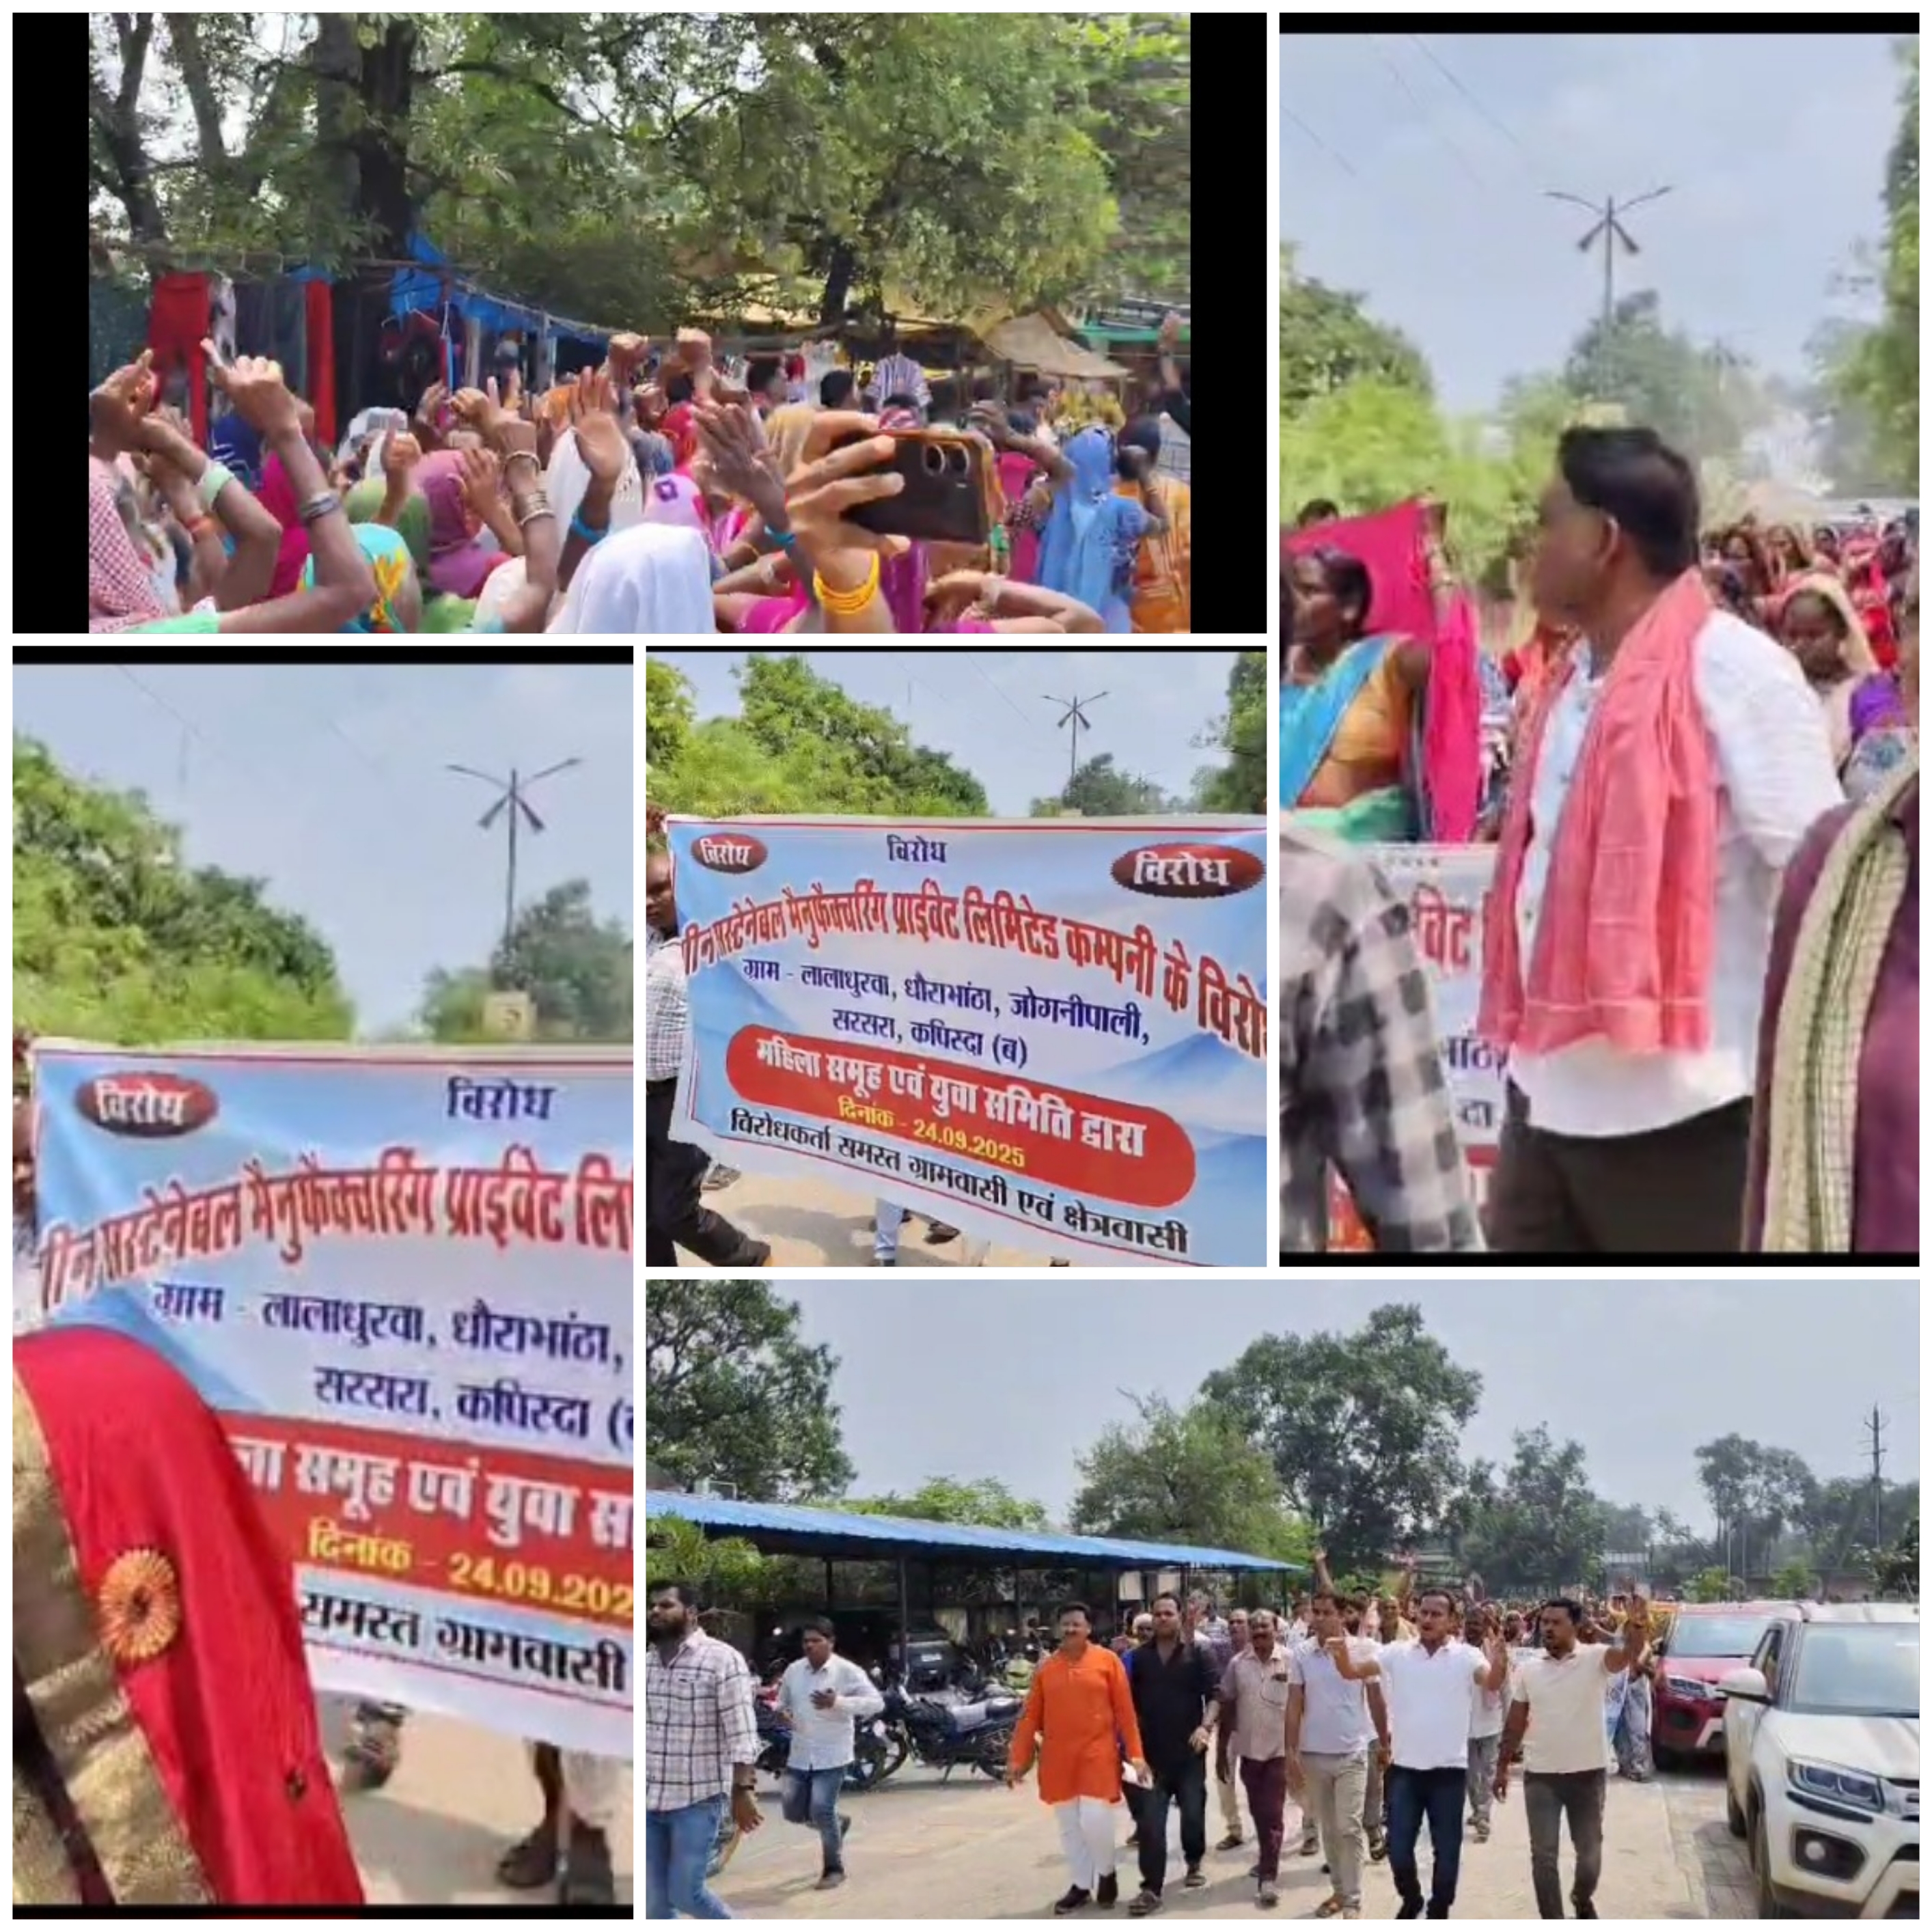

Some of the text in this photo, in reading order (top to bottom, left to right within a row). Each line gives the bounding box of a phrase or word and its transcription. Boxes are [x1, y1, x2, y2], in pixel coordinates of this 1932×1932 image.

[700, 838, 752, 866] विरोध
[887, 833, 948, 864] विरोध
[1133, 852, 1231, 887] विरोध
[743, 958, 780, 981] ग्राम
[800, 965, 897, 1002] लालाधुरवा,
[904, 970, 1000, 1019] धौराभांठा,
[1008, 986, 1150, 1046] जोगनीपाली,
[892, 878, 959, 942] प्राईवेट
[963, 886, 1059, 959] लिमिटेड
[1062, 918, 1158, 997] कम्पनी
[1163, 938, 1192, 1012] के
[1198, 954, 1267, 1058] विरो
[832, 1008, 902, 1044] सरसरा,
[992, 1032, 1028, 1069] (ब)
[95, 1079, 187, 1126] विरोध
[447, 1076, 557, 1120] विरोध
[756, 1036, 1148, 1157] महिला समूह एवं युवा समिति द्वारा
[838, 1094, 897, 1129] दिनांक
[913, 1118, 1025, 1168] 24.09.2025
[445, 1142, 569, 1248] प्राईवेट
[576, 1153, 634, 1252] लि
[730, 1107, 1189, 1254] विरोधकर्ता समस्त ग्रामवासी एवं क्षेत्रवासी
[154, 1282, 223, 1322] ग्राम
[260, 1293, 437, 1349] लालाधुरवा,
[452, 1297, 623, 1373] धौराभांठा,
[314, 1366, 441, 1420] सरसरा,
[293, 1442, 402, 1523] समूह
[407, 1457, 480, 1520] एवं
[484, 1472, 582, 1548] युवा
[308, 1515, 413, 1571] दिनांक
[301, 1588, 626, 1692] समस्त ग्रामवासी
